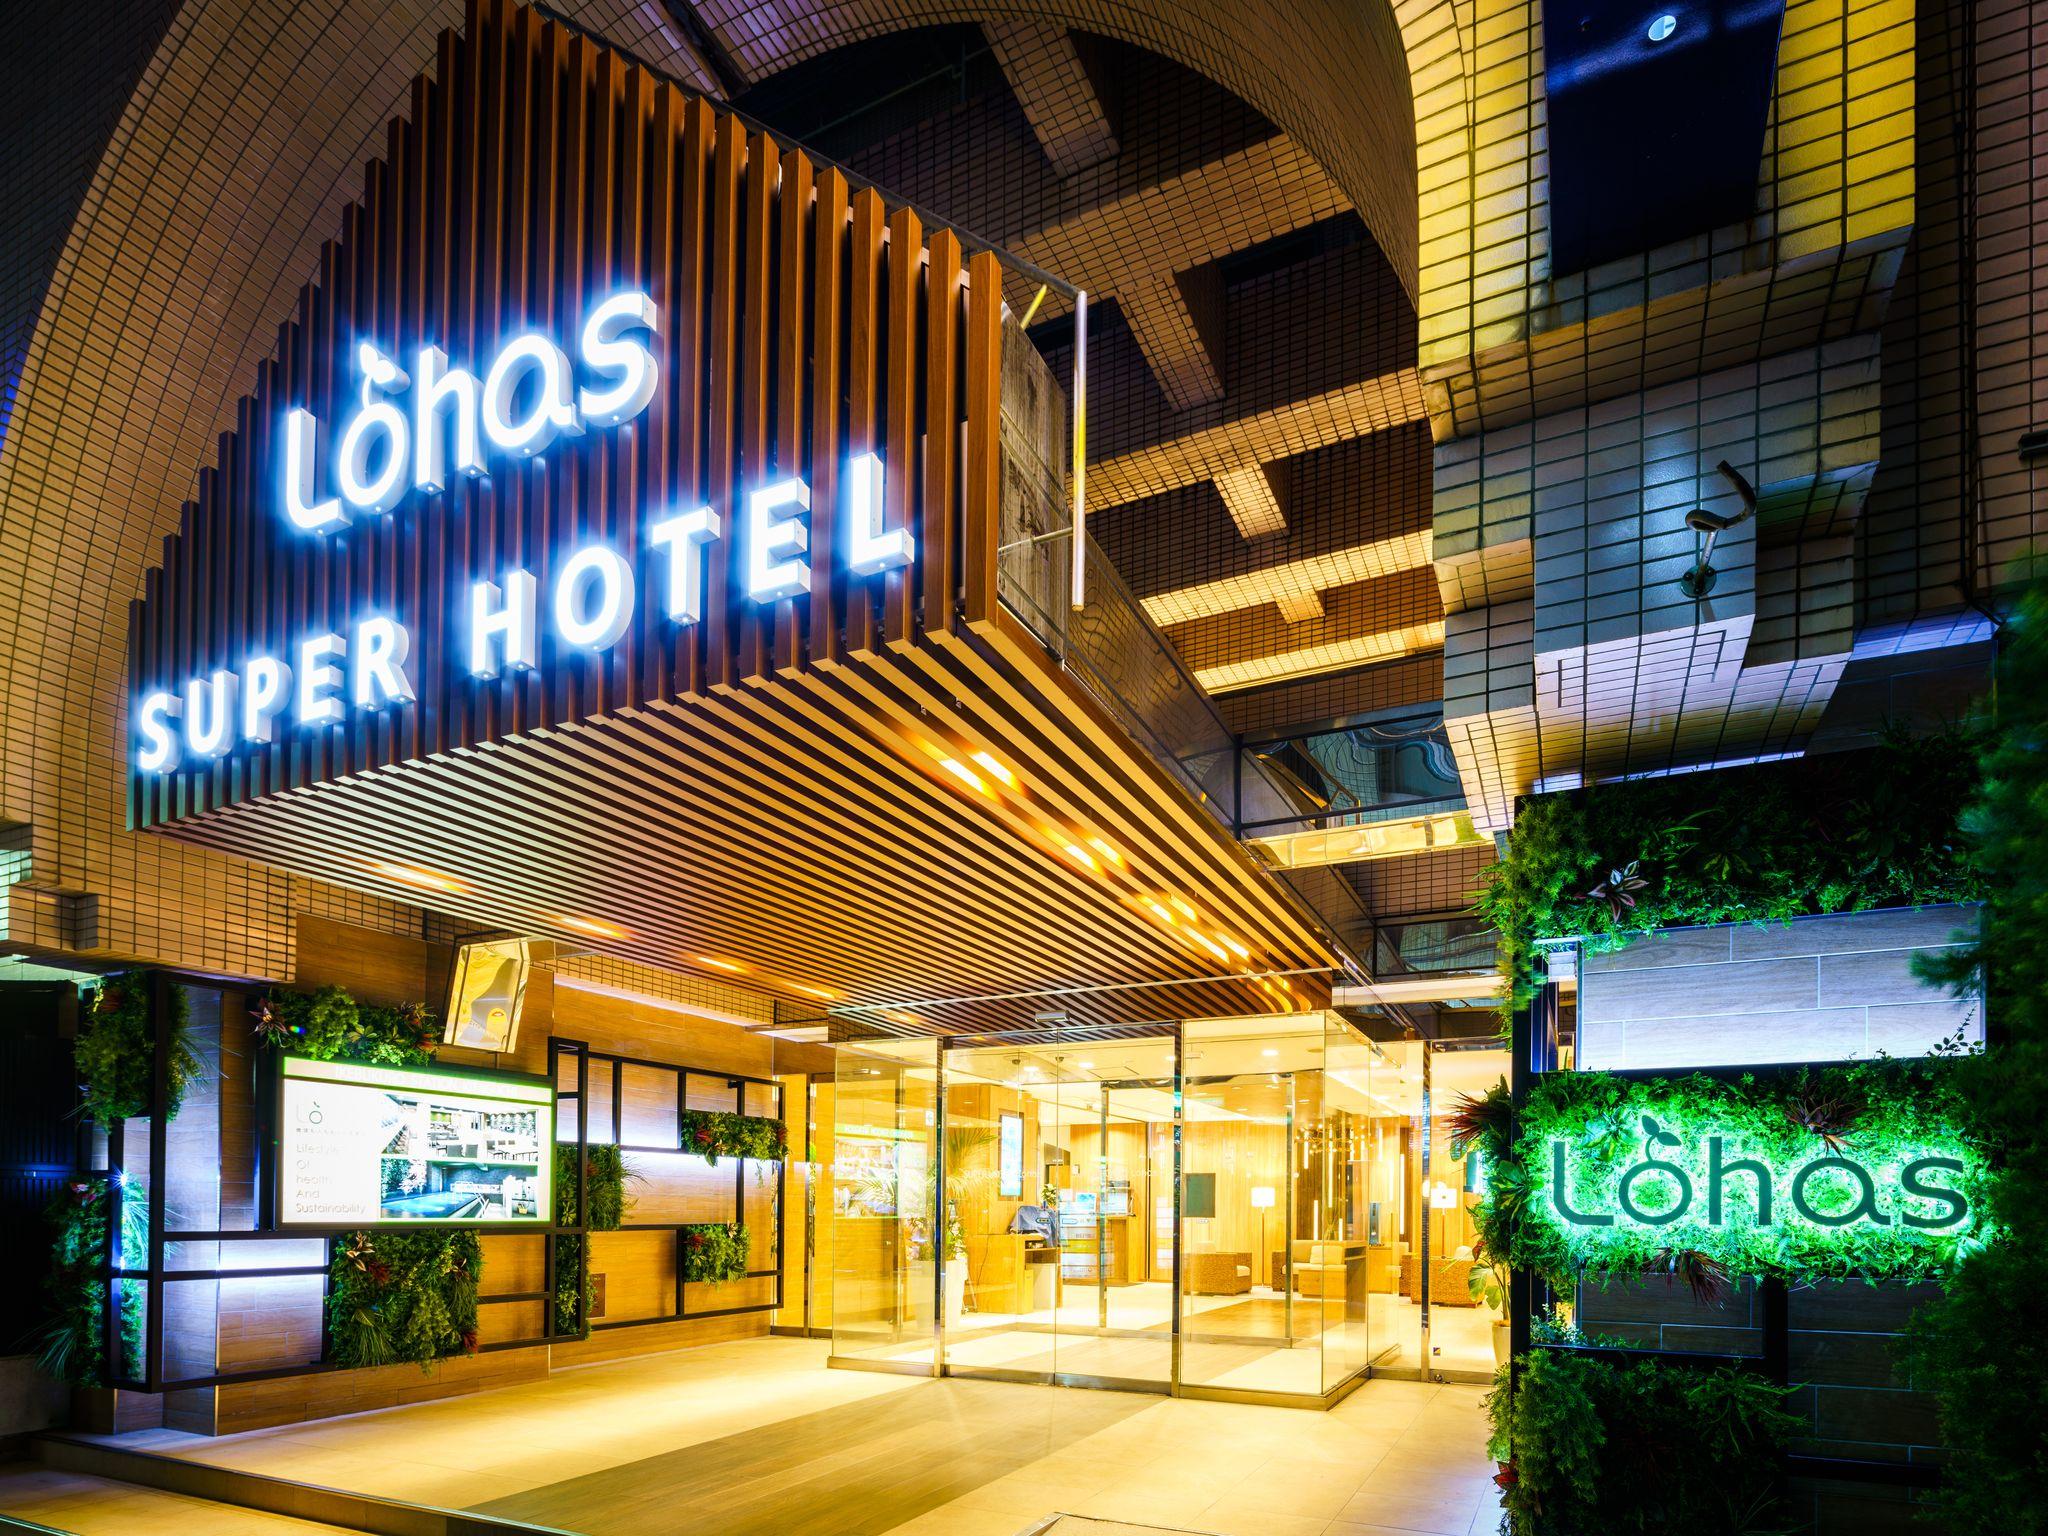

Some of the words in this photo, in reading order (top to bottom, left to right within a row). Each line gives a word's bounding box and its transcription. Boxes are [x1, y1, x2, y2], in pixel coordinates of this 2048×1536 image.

[286, 291, 659, 536] Lohas
[139, 617, 417, 775] SUPER
[470, 452, 915, 681] HOTEL
[296, 1202, 367, 1215] Sustainability
[1552, 1115, 1969, 1228] Lohas
